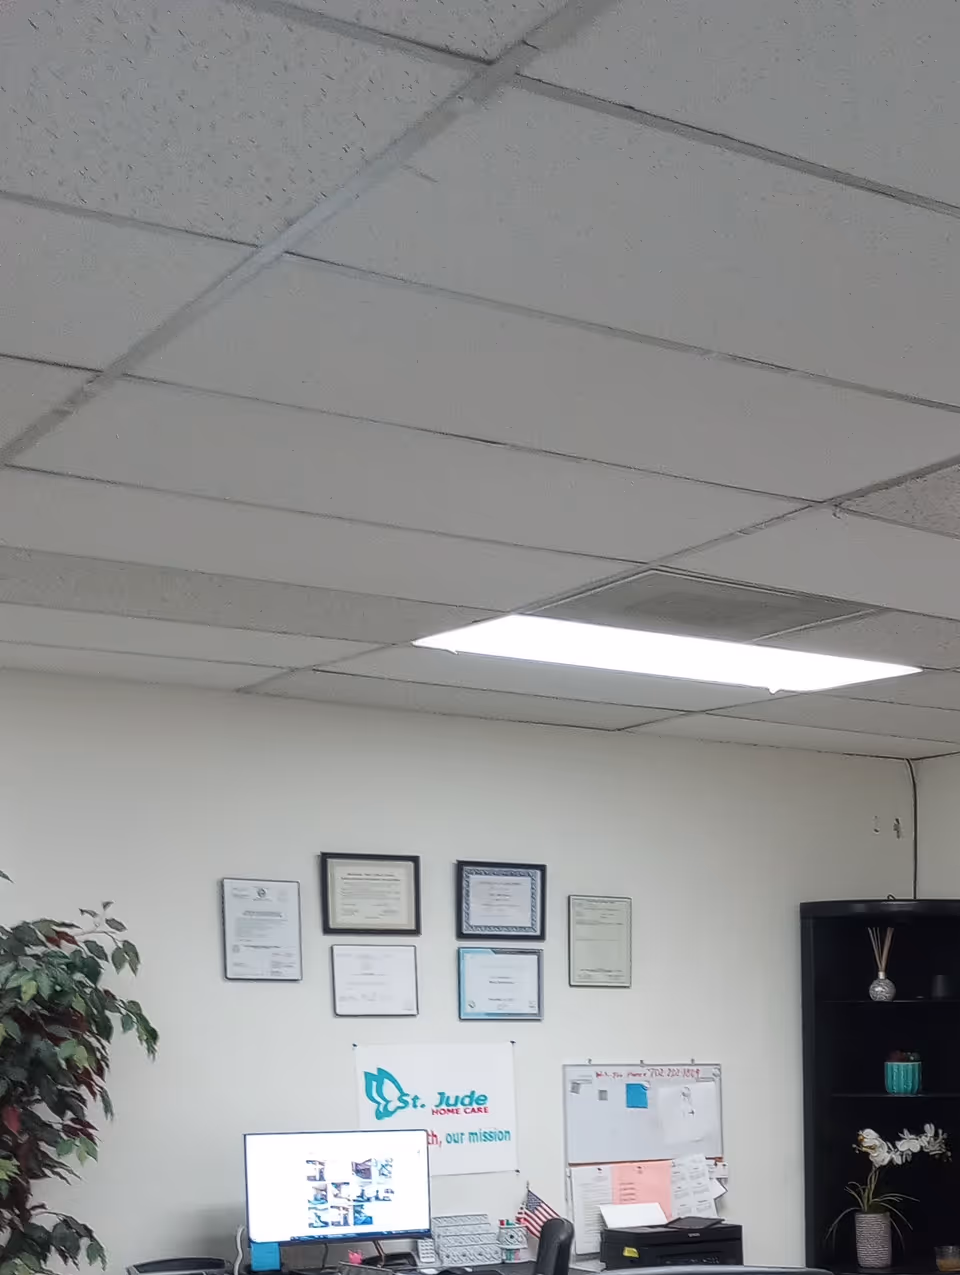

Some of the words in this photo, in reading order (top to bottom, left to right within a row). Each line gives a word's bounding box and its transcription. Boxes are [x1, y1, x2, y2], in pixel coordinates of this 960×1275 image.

[434, 1090, 488, 1107] Jude
[463, 1107, 489, 1115] CARE
[445, 1132, 464, 1144] our
[468, 1129, 511, 1143] mission
